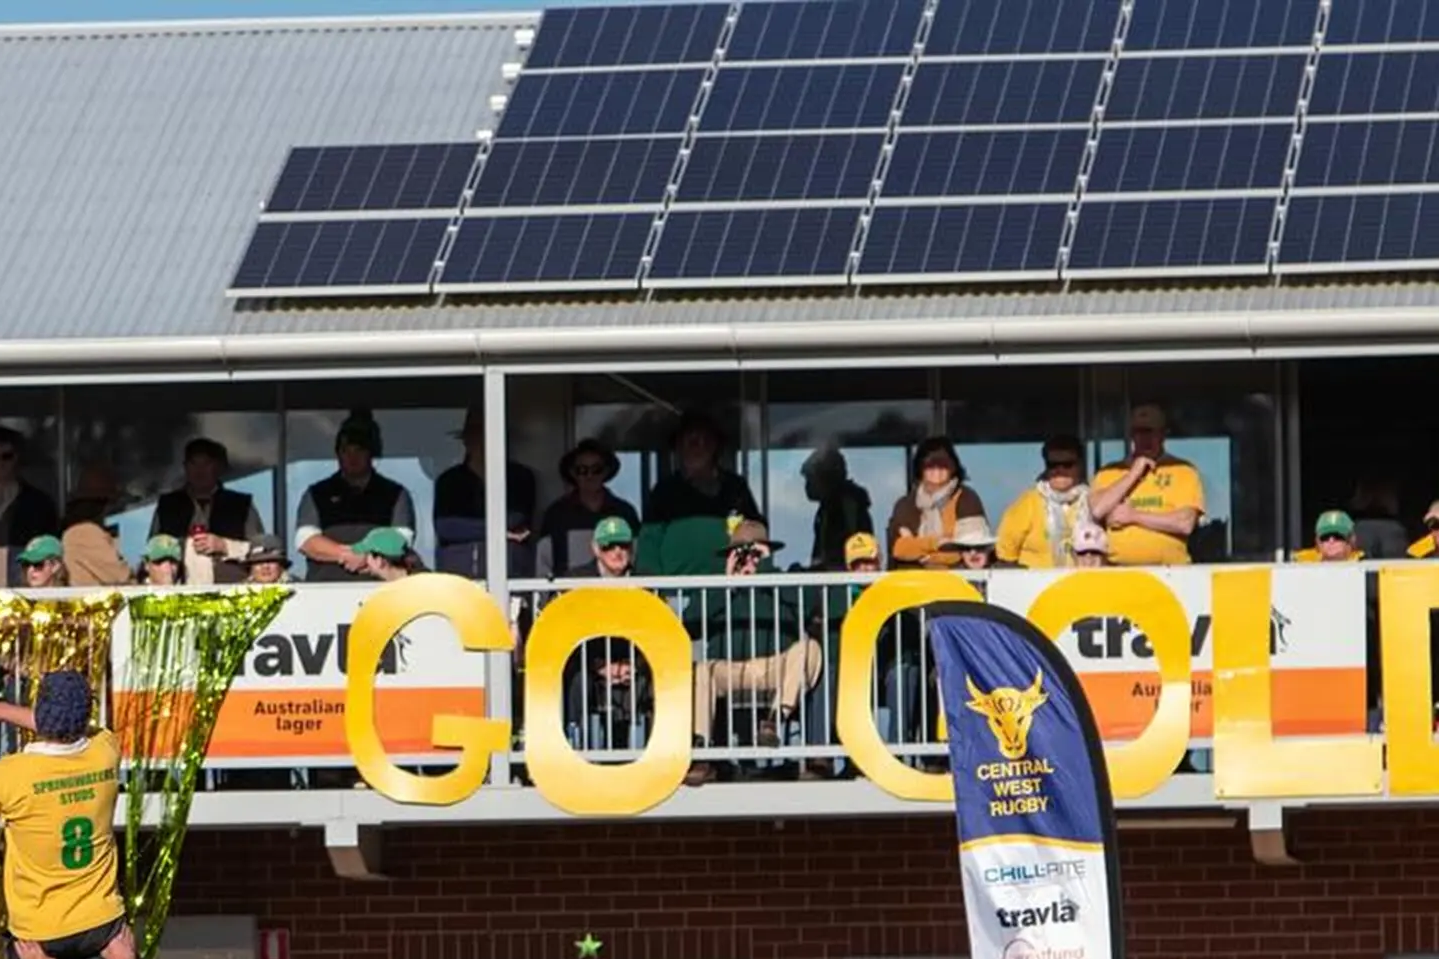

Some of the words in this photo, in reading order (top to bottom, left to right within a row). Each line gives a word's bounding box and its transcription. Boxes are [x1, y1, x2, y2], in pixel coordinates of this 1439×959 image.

[346, 572, 693, 816] GO
[254, 701, 345, 716] Australian
[277, 717, 323, 734] lager
[977, 759, 1054, 780] CENTRAL
[994, 778, 1042, 797] WEST
[990, 797, 1049, 816] RUGBY
[62, 816, 94, 870] 8
[996, 901, 1077, 928] travla
